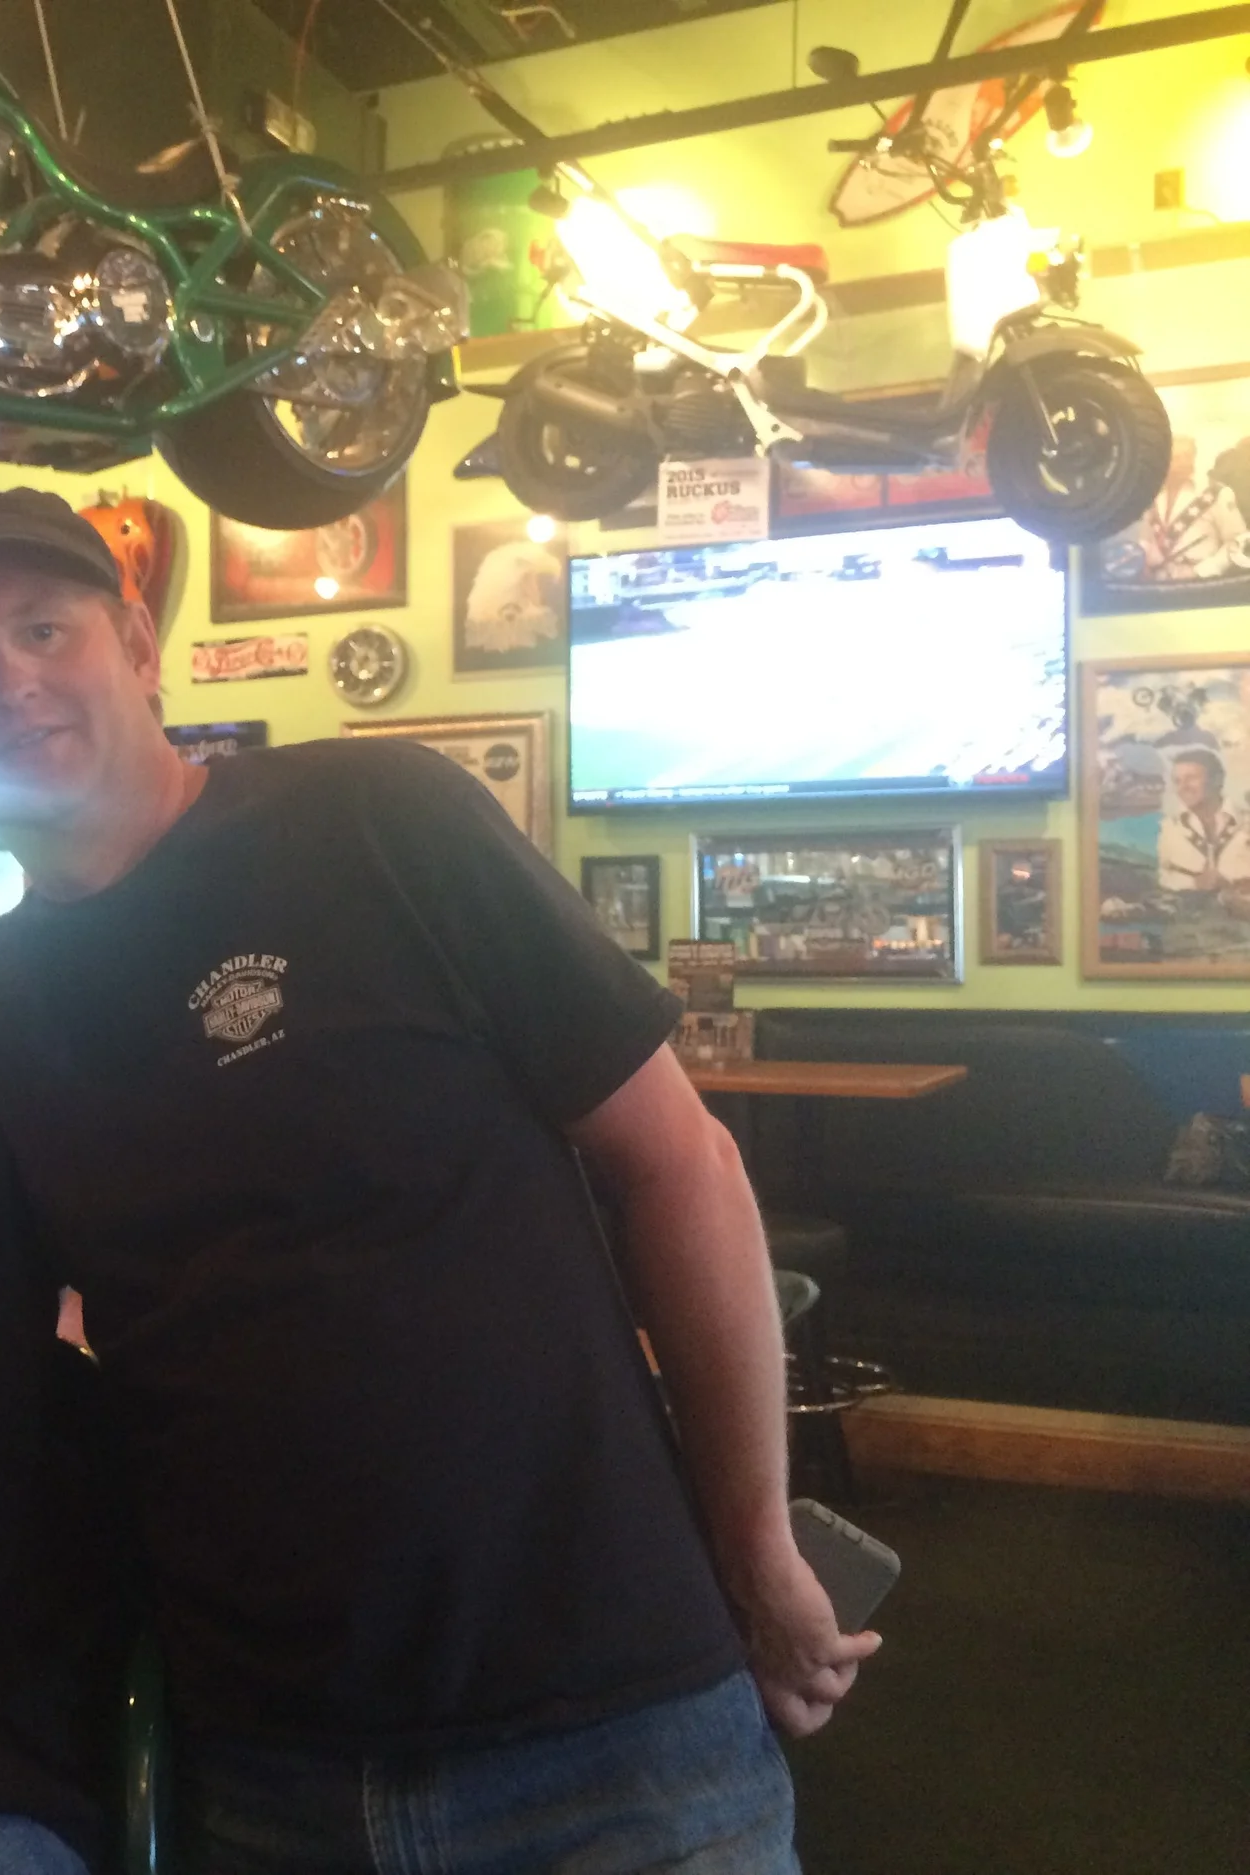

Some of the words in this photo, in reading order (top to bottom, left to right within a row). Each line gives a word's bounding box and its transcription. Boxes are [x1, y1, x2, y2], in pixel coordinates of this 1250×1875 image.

[667, 467, 706, 483] 2015
[666, 480, 741, 498] RUCKUS
[188, 954, 288, 1010] CHANDLER
